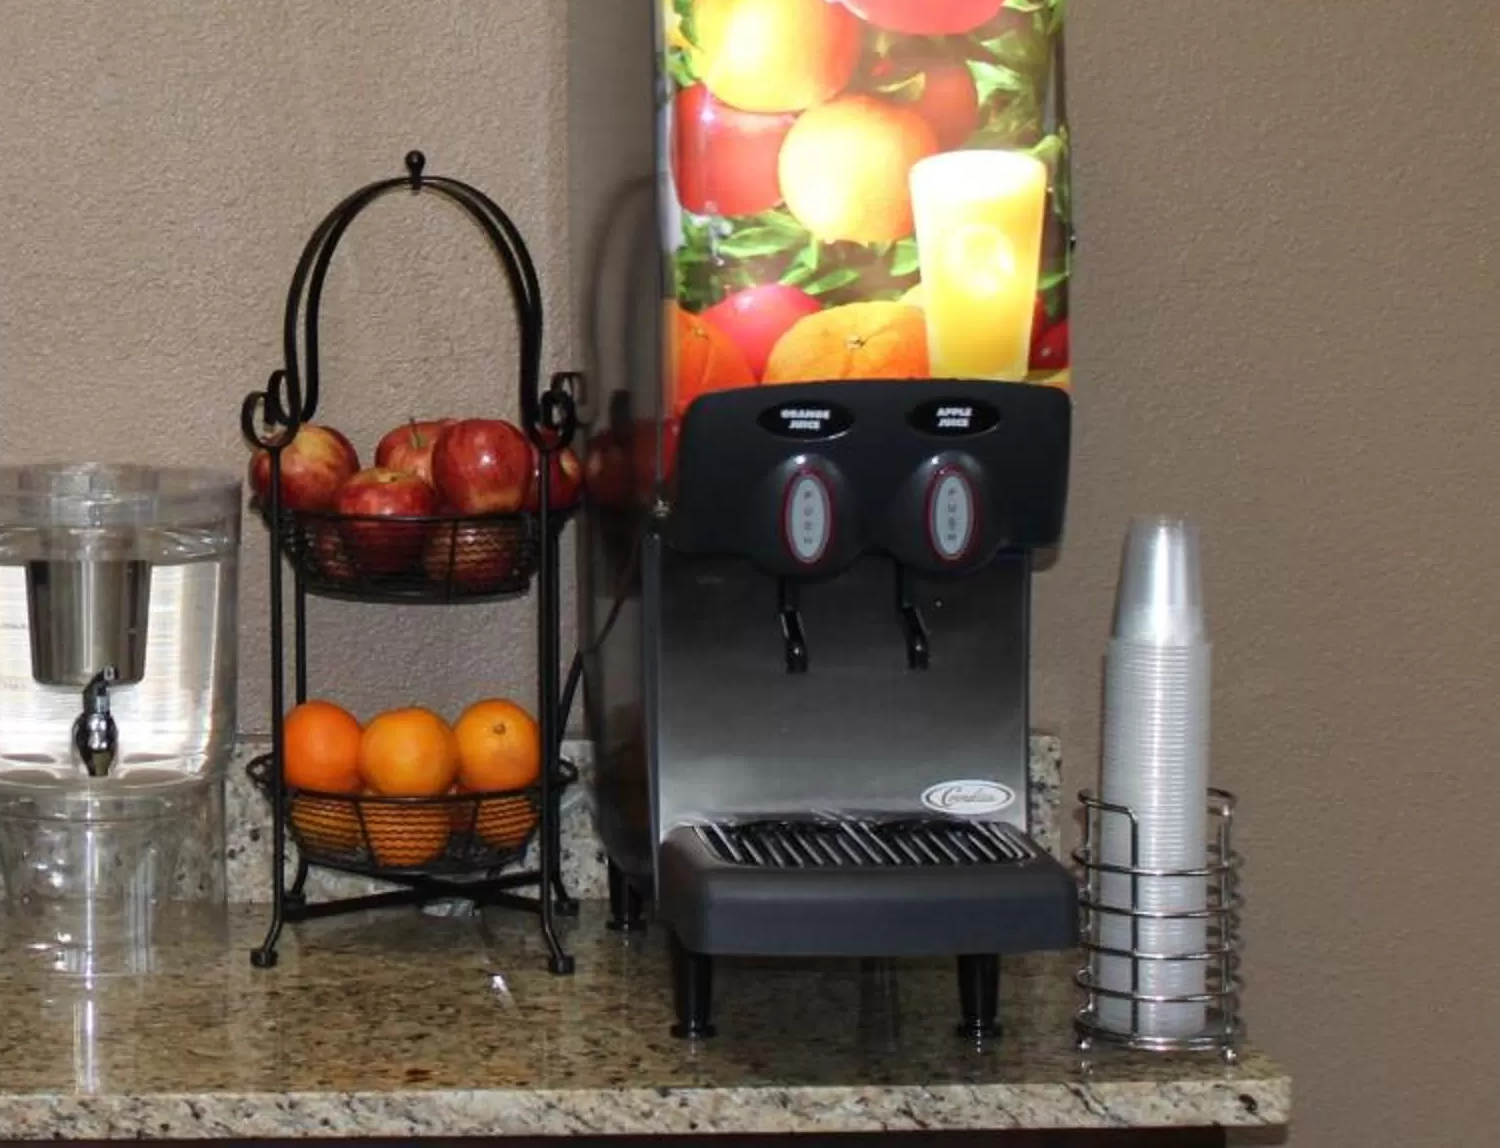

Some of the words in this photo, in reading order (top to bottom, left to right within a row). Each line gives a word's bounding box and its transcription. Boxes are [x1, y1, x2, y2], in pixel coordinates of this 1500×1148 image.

[936, 407, 973, 418] APPLE
[788, 420, 821, 430] JUICE
[937, 418, 970, 428] JUICE
